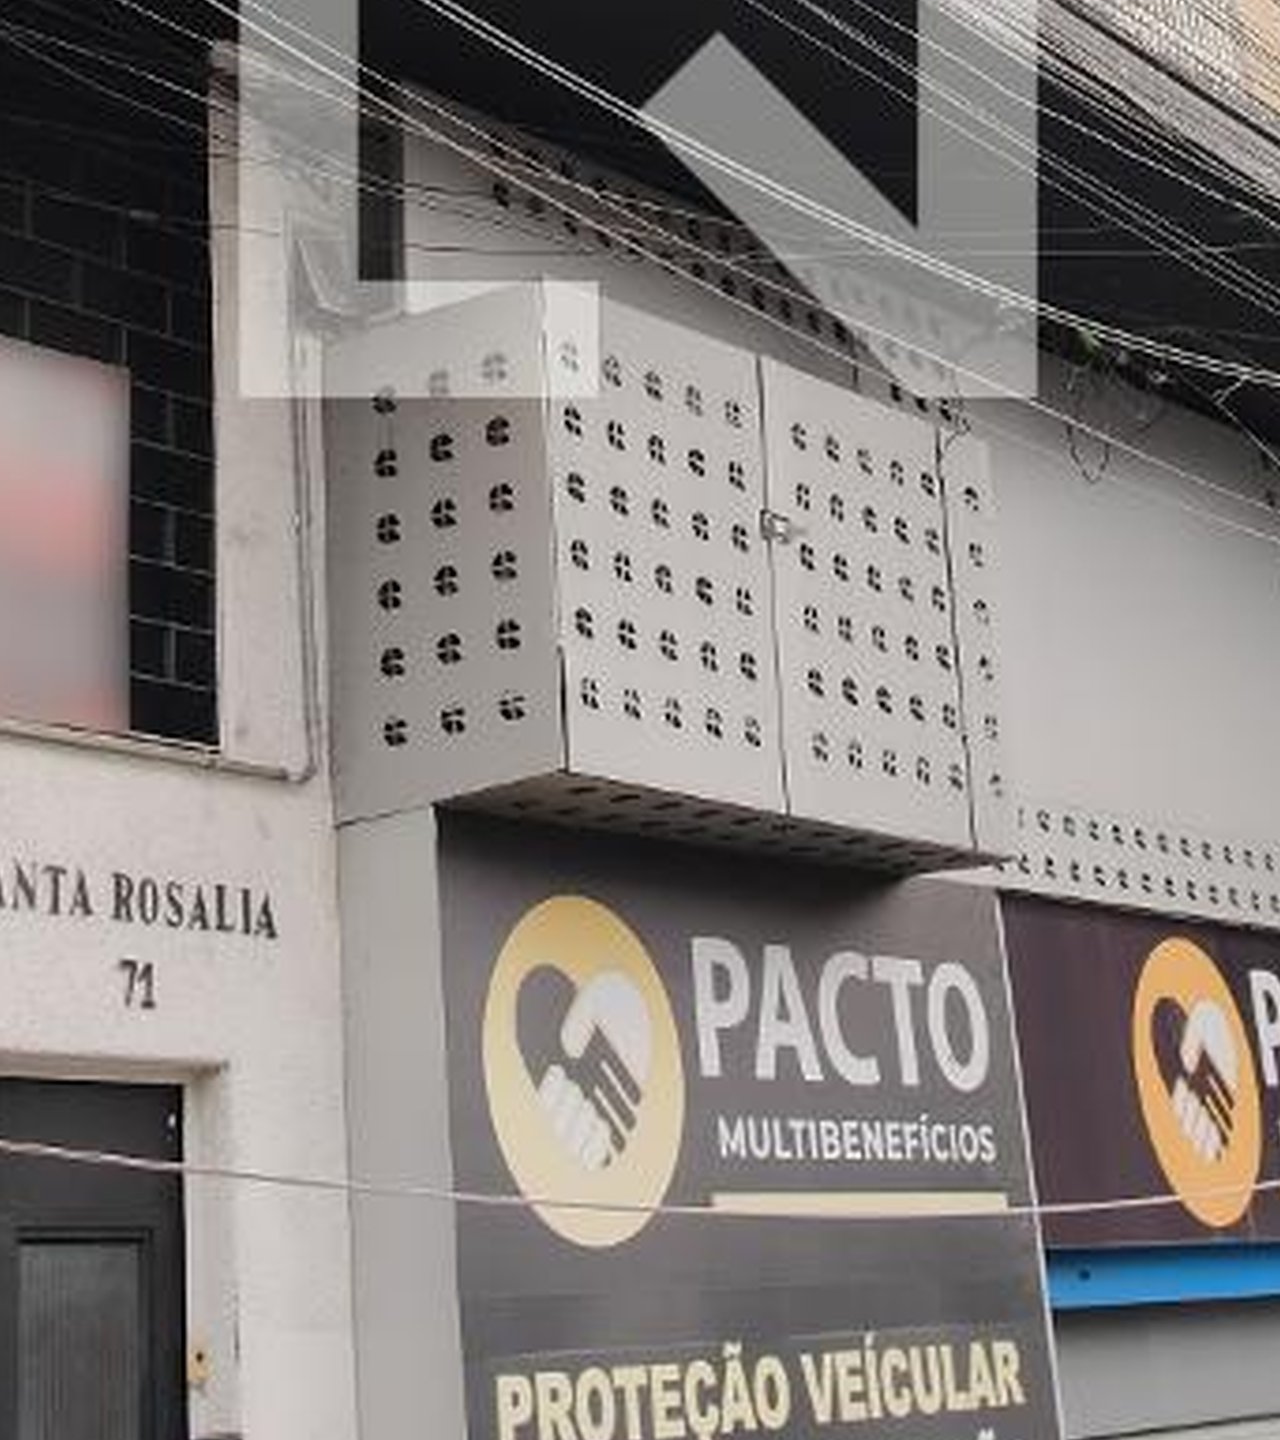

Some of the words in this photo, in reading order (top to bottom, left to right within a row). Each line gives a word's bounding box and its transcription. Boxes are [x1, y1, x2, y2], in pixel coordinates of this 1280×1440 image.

[112, 871, 279, 940] ROSALIA
[118, 959, 157, 1010] 71
[691, 935, 991, 1094] PACTO
[718, 1114, 997, 1163] MULTIBENEFÍCIOS
[801, 1334, 1027, 1425] VEÍCULAR
